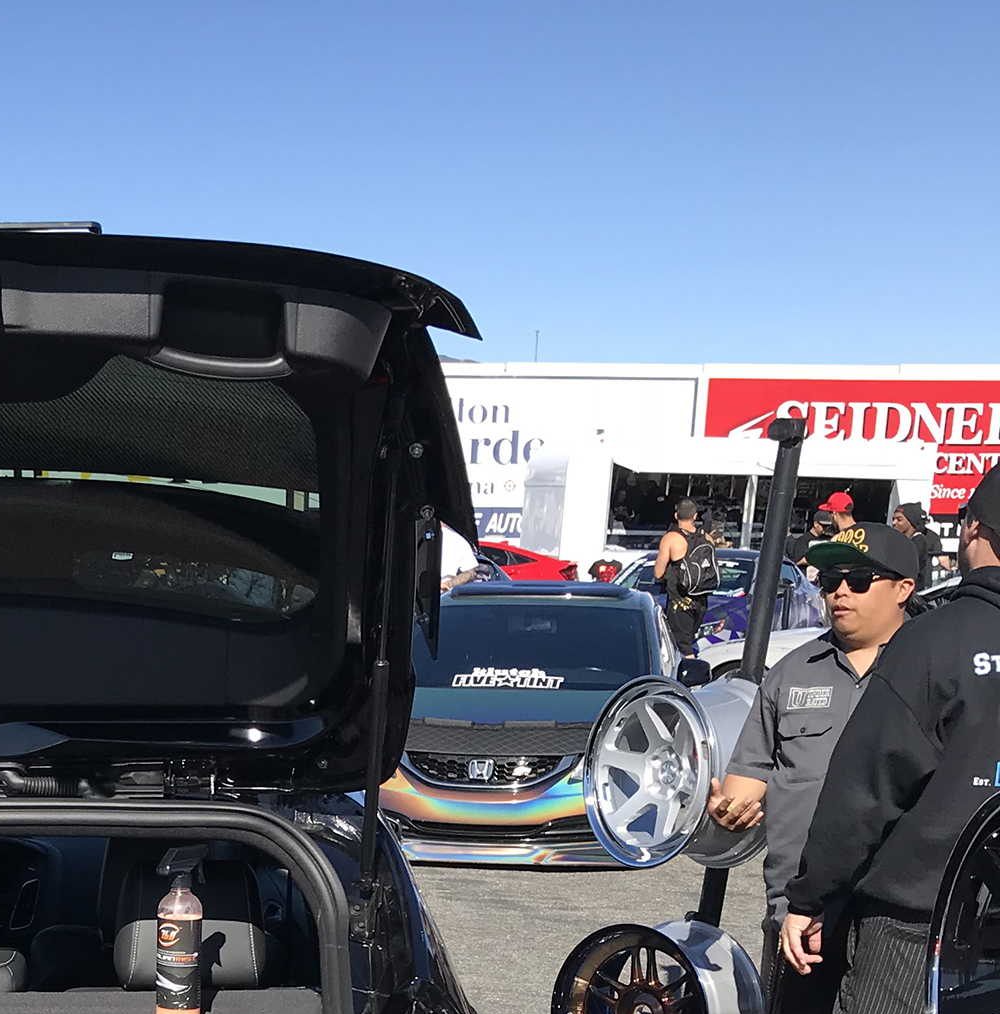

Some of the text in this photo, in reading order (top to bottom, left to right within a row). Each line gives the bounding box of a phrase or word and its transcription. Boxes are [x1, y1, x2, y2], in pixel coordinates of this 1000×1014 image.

[468, 430, 545, 466] rde
[934, 452, 1000, 475] CENT
[930, 483, 966, 500] Since
[972, 651, 1000, 676] ST
